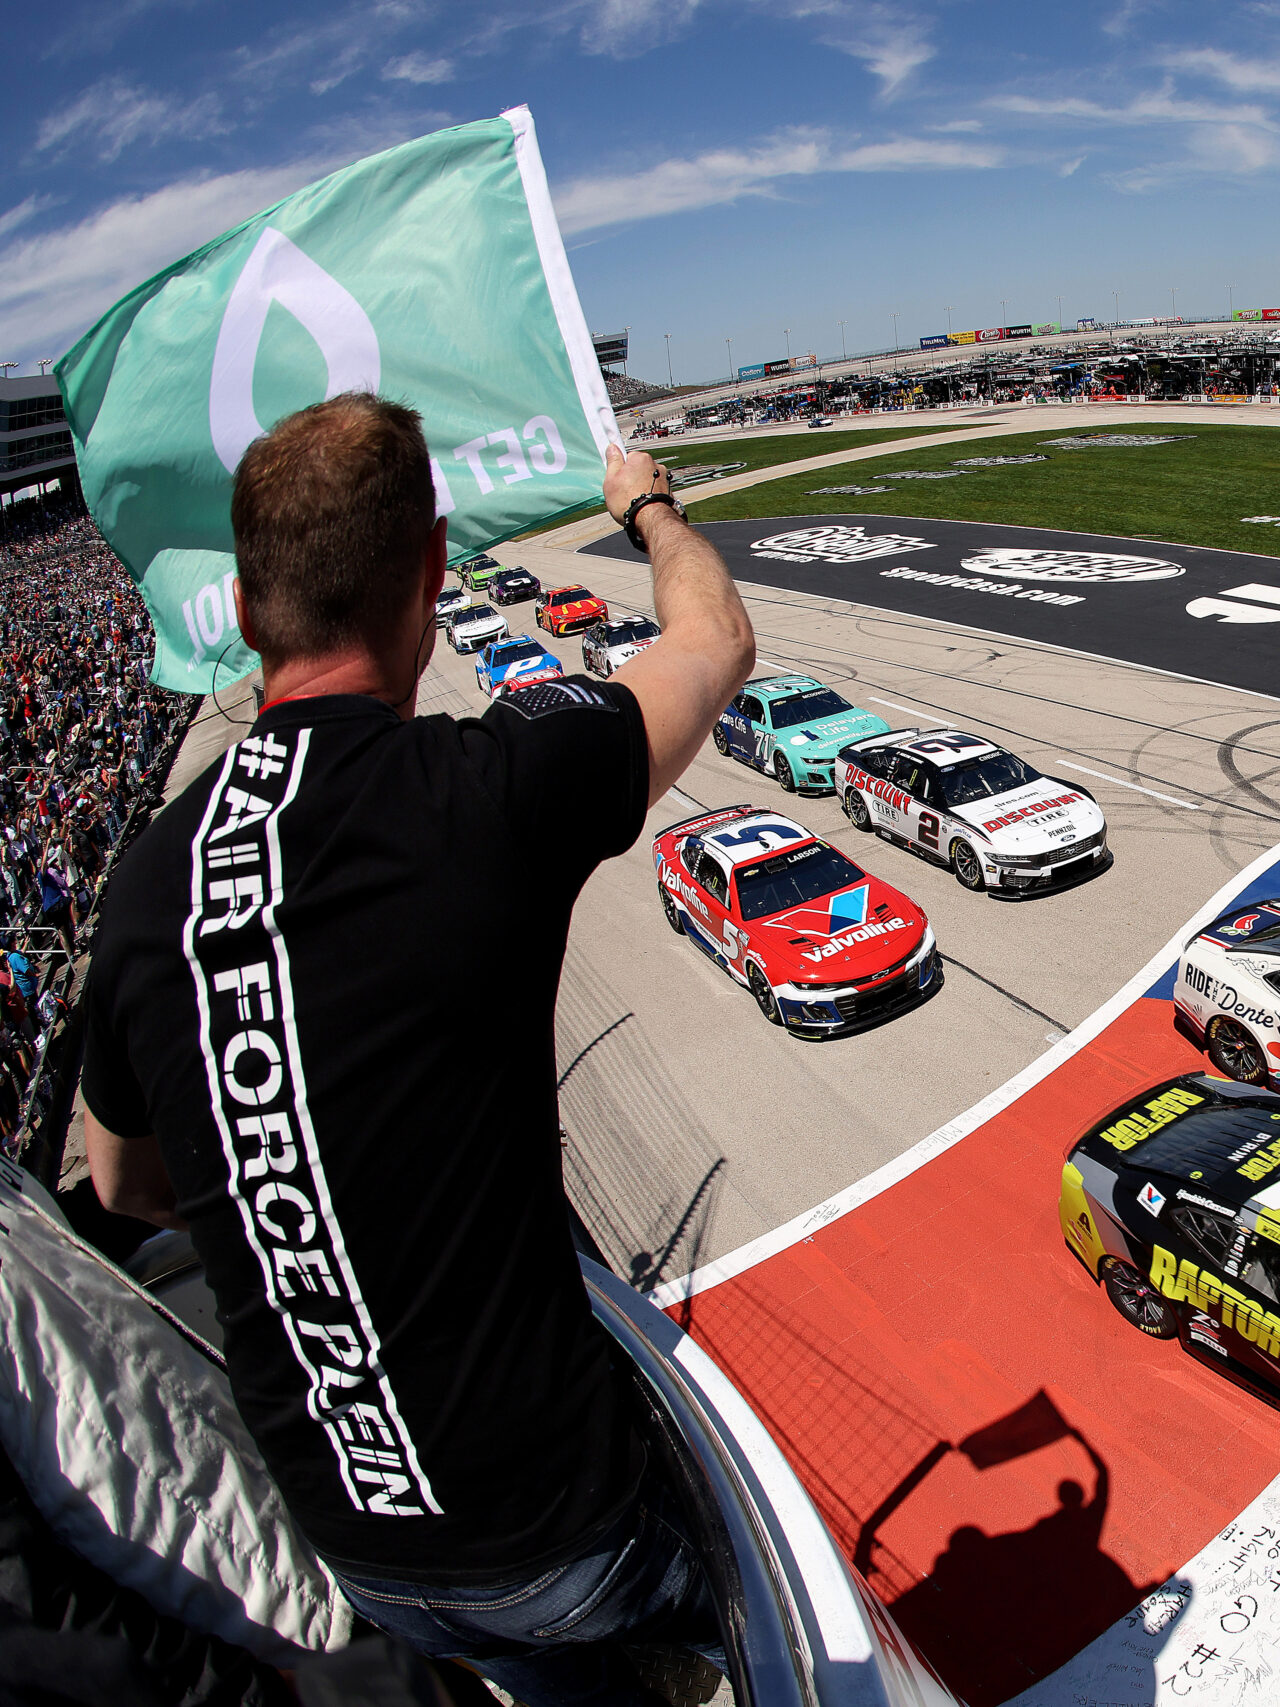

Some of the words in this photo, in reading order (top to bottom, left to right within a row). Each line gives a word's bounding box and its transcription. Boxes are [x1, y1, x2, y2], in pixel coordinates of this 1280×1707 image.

[879, 566, 1087, 606] SpeedyCash.com
[815, 712, 876, 731] Delaware
[822, 725, 850, 737] Life
[754, 730, 772, 762] 71
[908, 734, 988, 754] 2
[844, 762, 914, 816] DISCOUNT
[993, 789, 1039, 809] tires.com
[671, 811, 742, 836] Valvoline
[875, 801, 898, 822] TIRE
[981, 791, 1087, 834] DISCOUNT
[1031, 809, 1066, 827] TIRE
[711, 823, 805, 849] 5
[917, 810, 940, 851] 2
[1047, 822, 1078, 839] PENNZOIL
[785, 845, 822, 865] LARSON
[661, 864, 711, 918] Valvoline
[721, 917, 741, 961] 5
[800, 915, 908, 964] Valvoline
[1184, 962, 1214, 1001] RIDE
[1099, 1086, 1205, 1153] RAPTOR
[1226, 1132, 1273, 1163] BYRON
[213, 960, 339, 1299] FORCE
[296, 1322, 425, 1518] PLEIN
